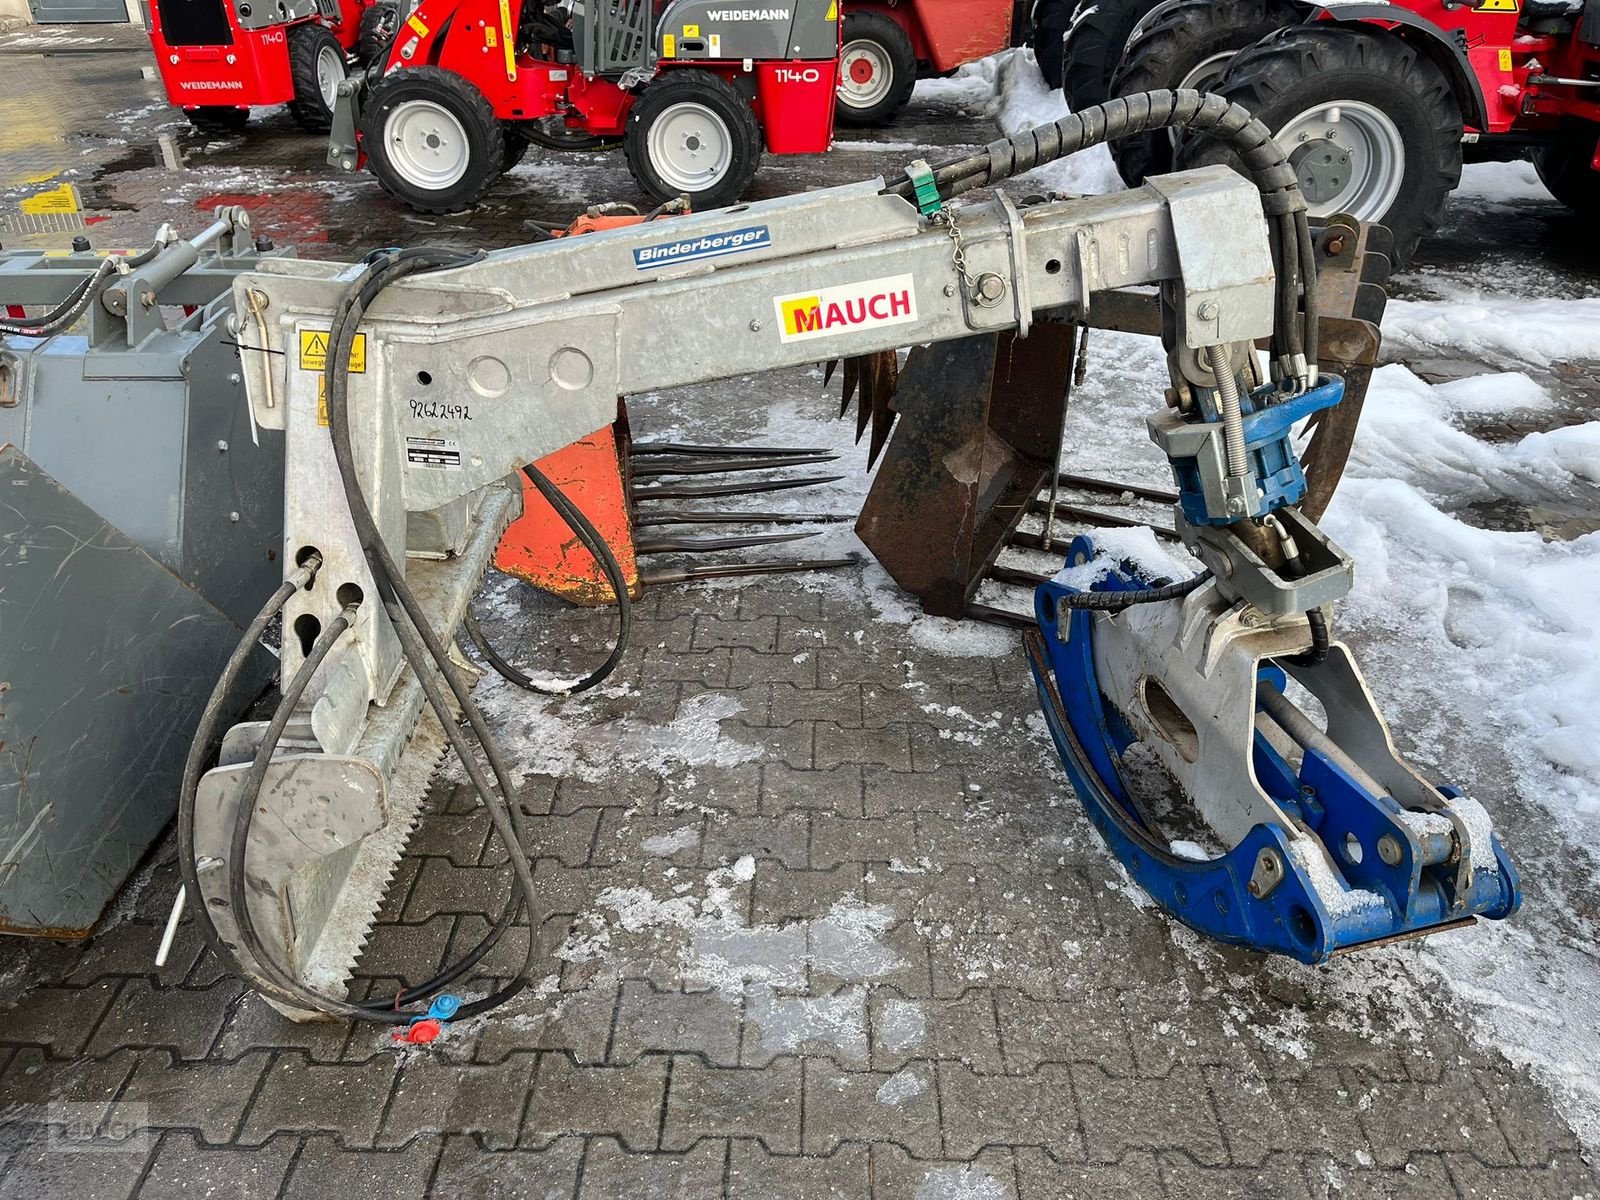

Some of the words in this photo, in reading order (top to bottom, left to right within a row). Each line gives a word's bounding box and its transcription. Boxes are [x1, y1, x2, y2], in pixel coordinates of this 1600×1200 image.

[706, 9, 789, 21] WEIDEMANN
[260, 31, 284, 45] 1140
[775, 69, 820, 83] 1140
[180, 81, 243, 90] WEIDEMANN
[638, 229, 765, 261] Binderberger
[793, 289, 911, 334] MAUCH
[409, 399, 473, 421] 92622492
